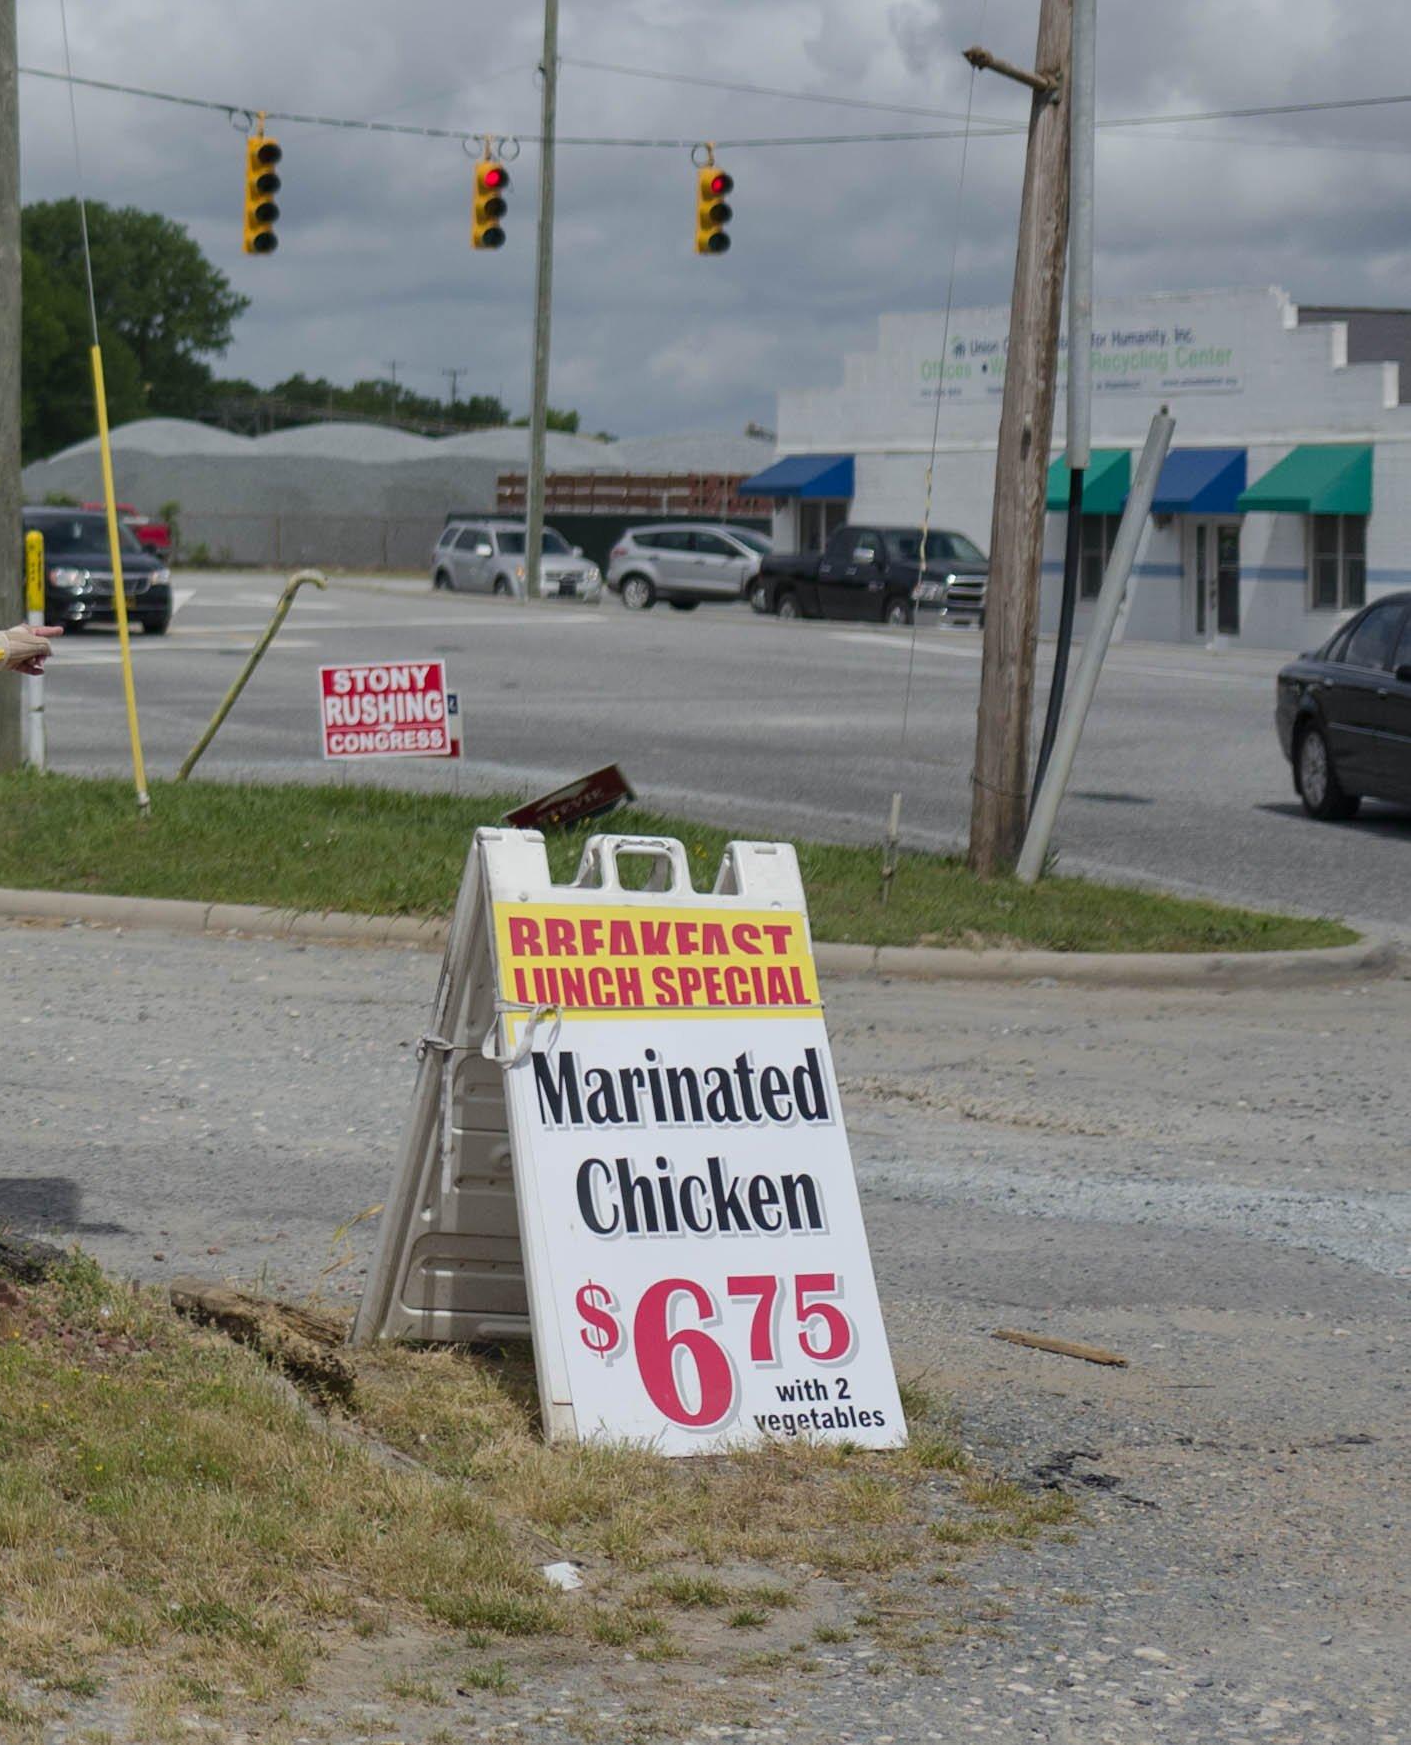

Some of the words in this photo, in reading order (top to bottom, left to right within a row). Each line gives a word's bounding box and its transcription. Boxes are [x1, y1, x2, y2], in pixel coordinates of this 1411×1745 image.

[333, 666, 430, 694] STONY
[326, 690, 444, 727] RUSHING
[329, 729, 444, 753] CONGRESS
[514, 966, 644, 1006] LUNCH
[651, 965, 812, 1006] SPECIAL
[532, 1047, 830, 1126] Marinated
[576, 1156, 823, 1235] Chicken
[775, 1378, 828, 1402] with
[835, 1377, 851, 1400] 2
[753, 1406, 886, 1437] vegetables
